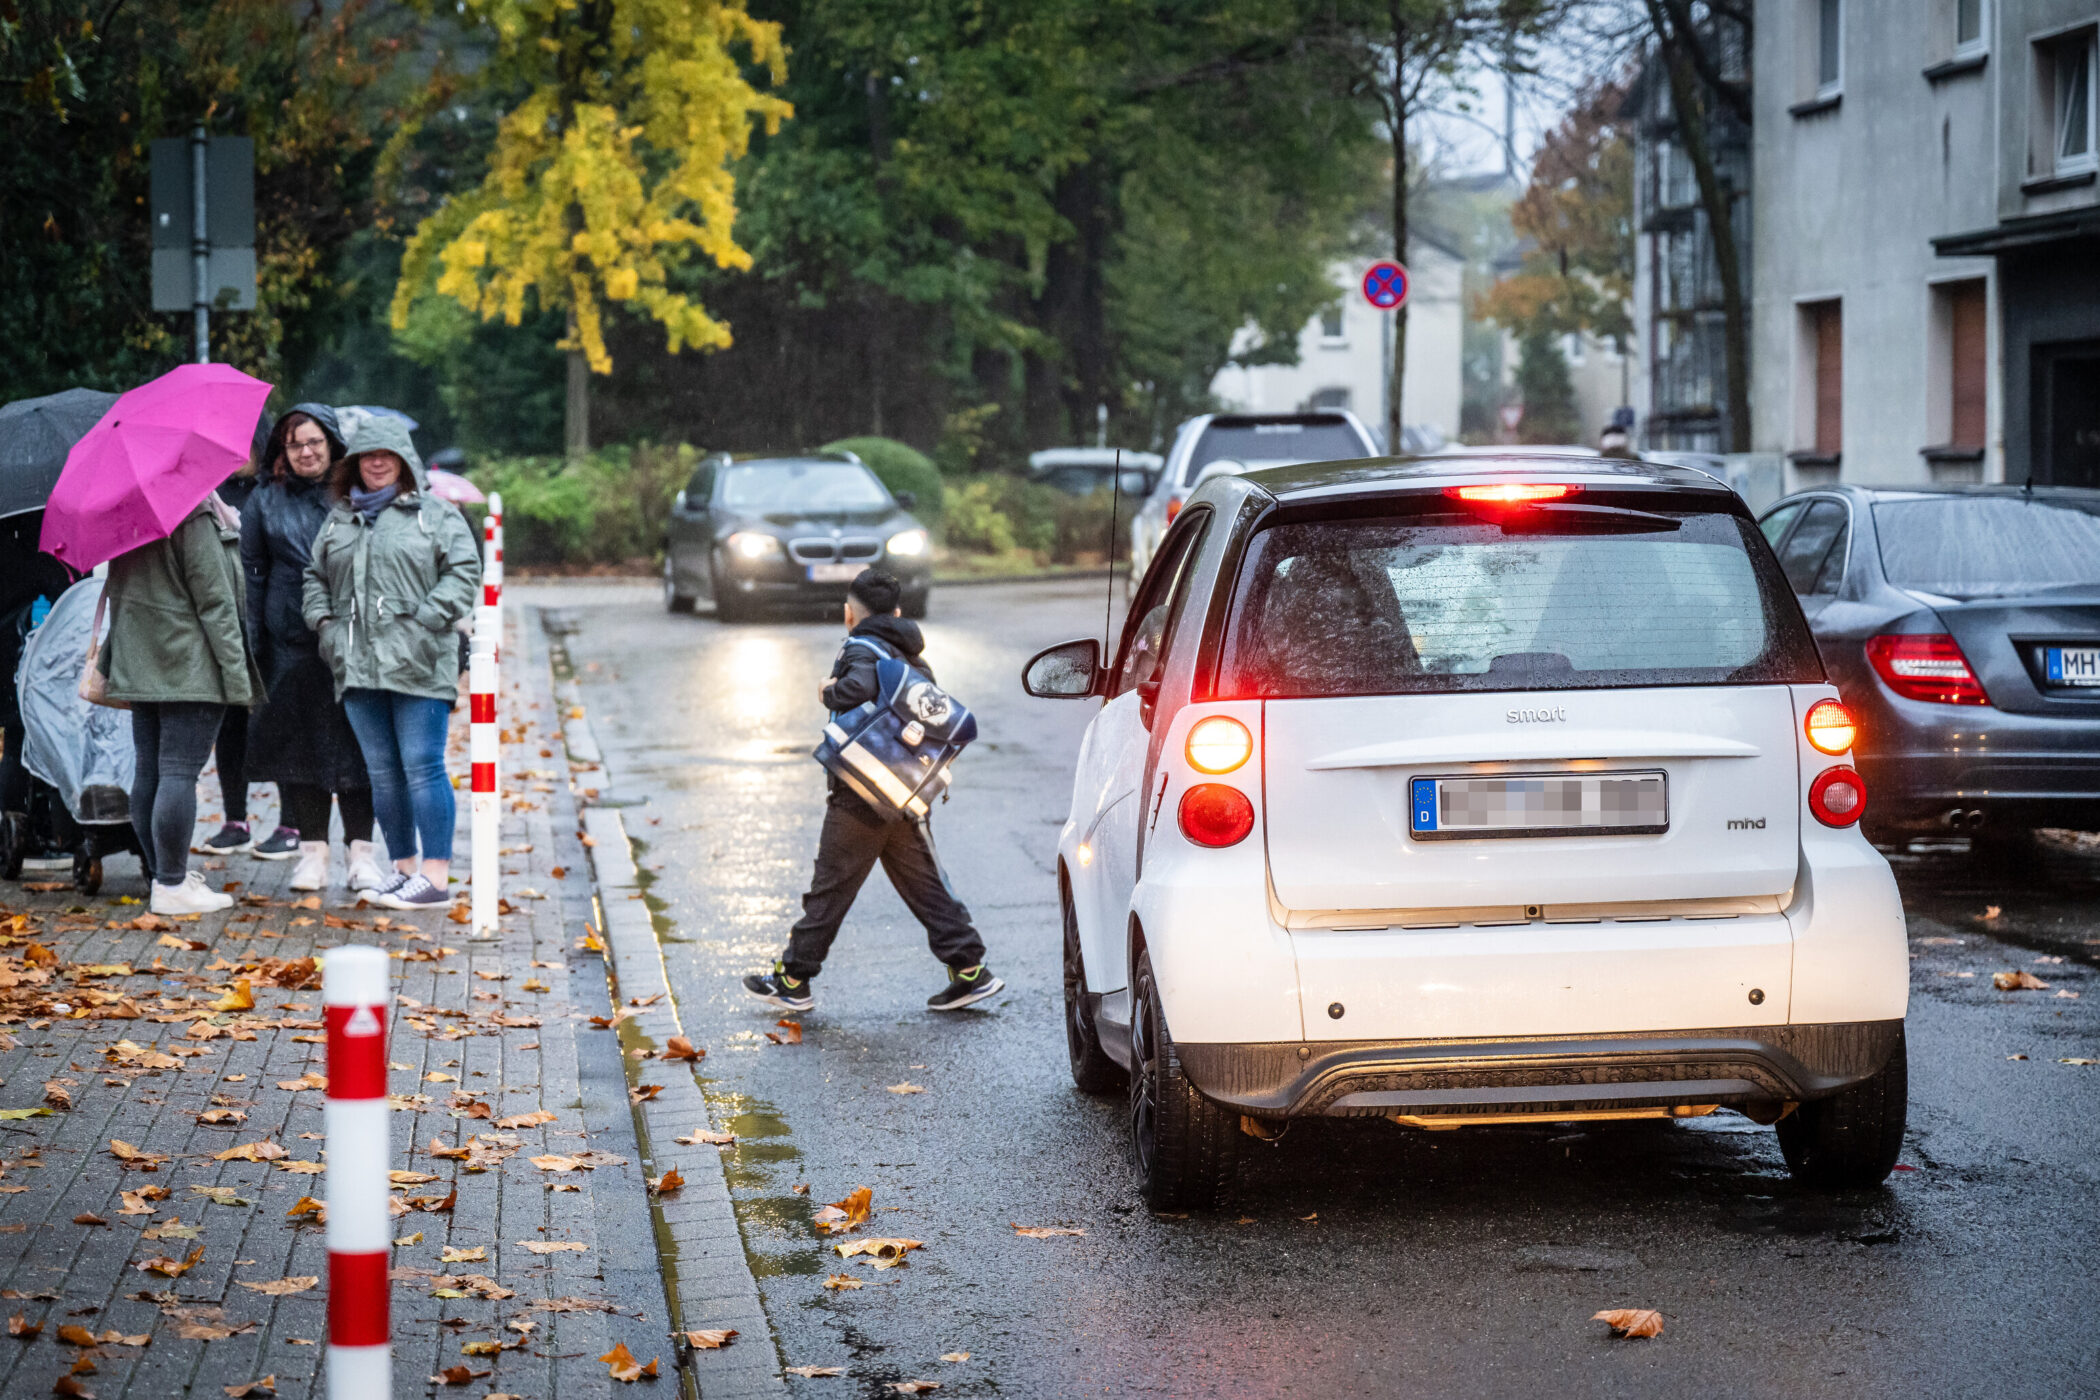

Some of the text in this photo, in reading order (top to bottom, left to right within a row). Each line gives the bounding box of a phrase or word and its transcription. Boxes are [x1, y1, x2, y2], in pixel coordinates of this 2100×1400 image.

[2064, 653, 2095, 675] MH
[1506, 705, 1566, 723] smart
[1421, 811, 1429, 822] D
[1727, 817, 1766, 830] mhd
